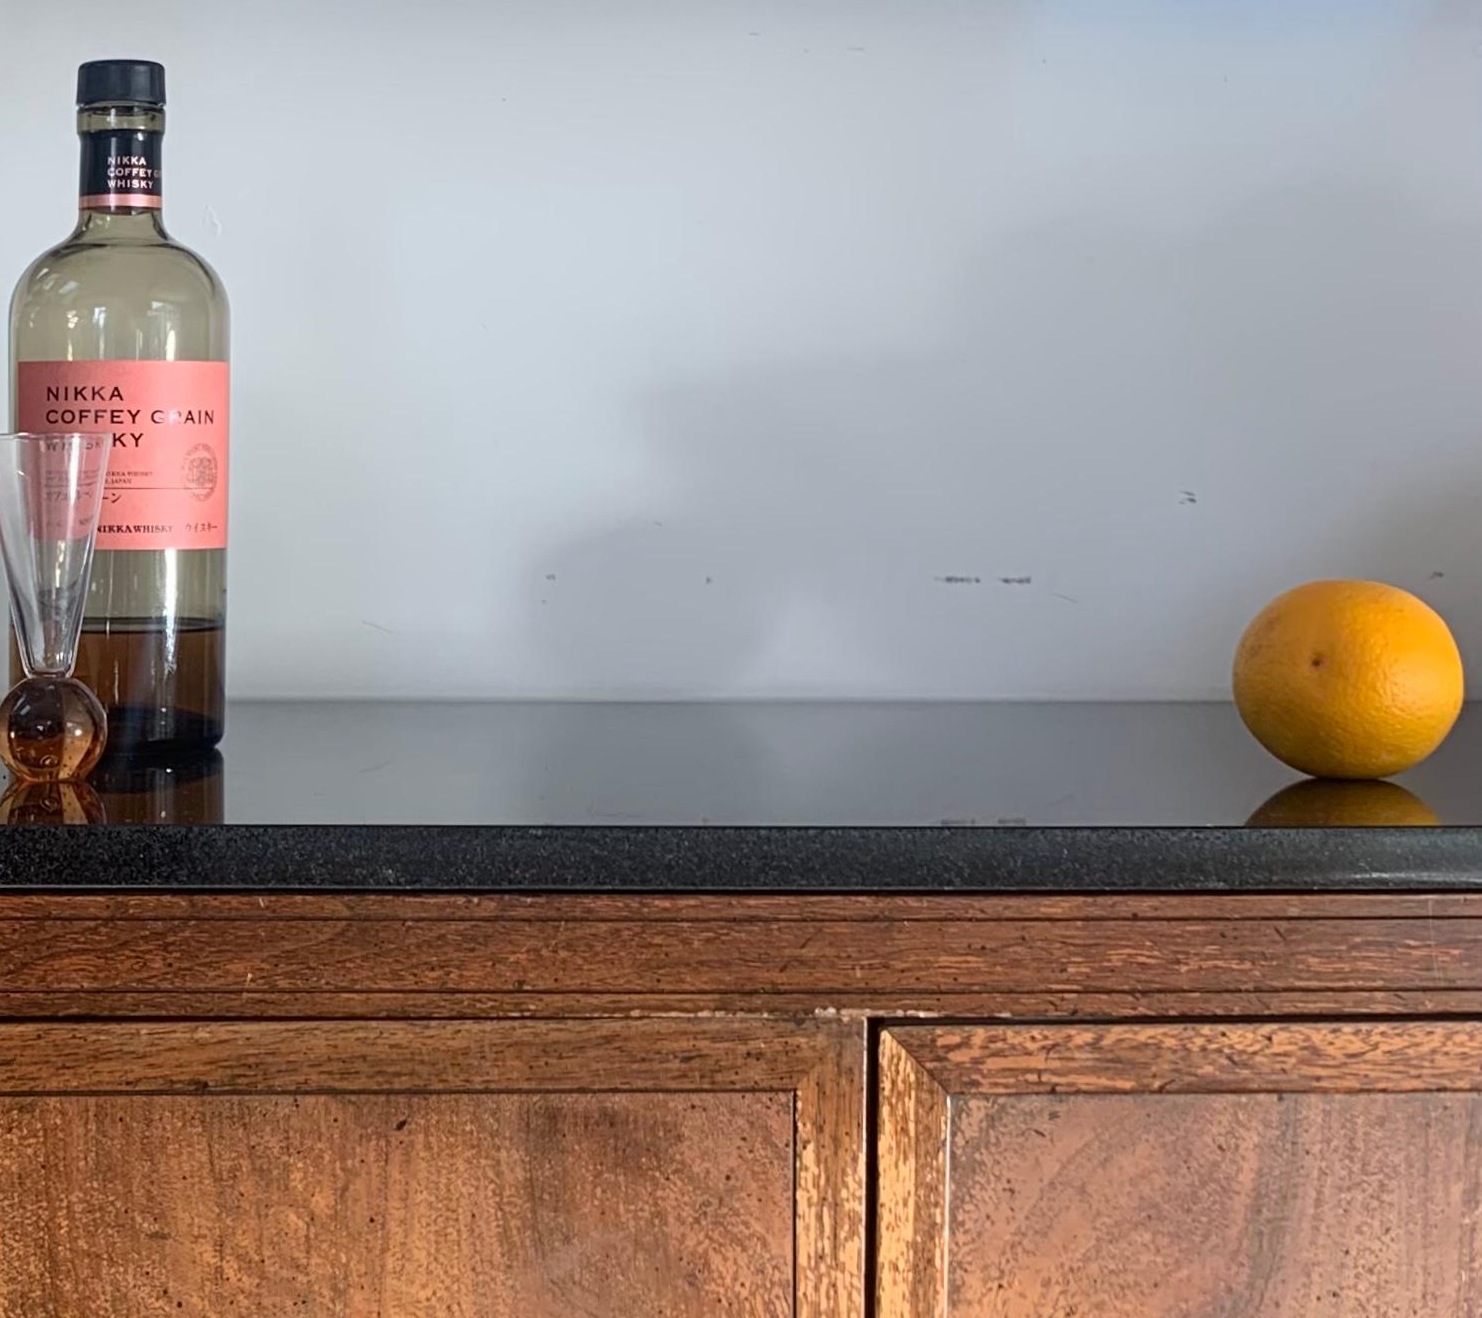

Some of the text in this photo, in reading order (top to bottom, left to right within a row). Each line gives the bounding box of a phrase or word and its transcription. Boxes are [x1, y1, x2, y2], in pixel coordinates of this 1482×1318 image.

[107, 155, 147, 166] NIKKA
[107, 167, 152, 178] COFFEY
[107, 179, 153, 189] WHISKY
[46, 386, 124, 402] NIKKA
[45, 409, 142, 425] COFFEY
